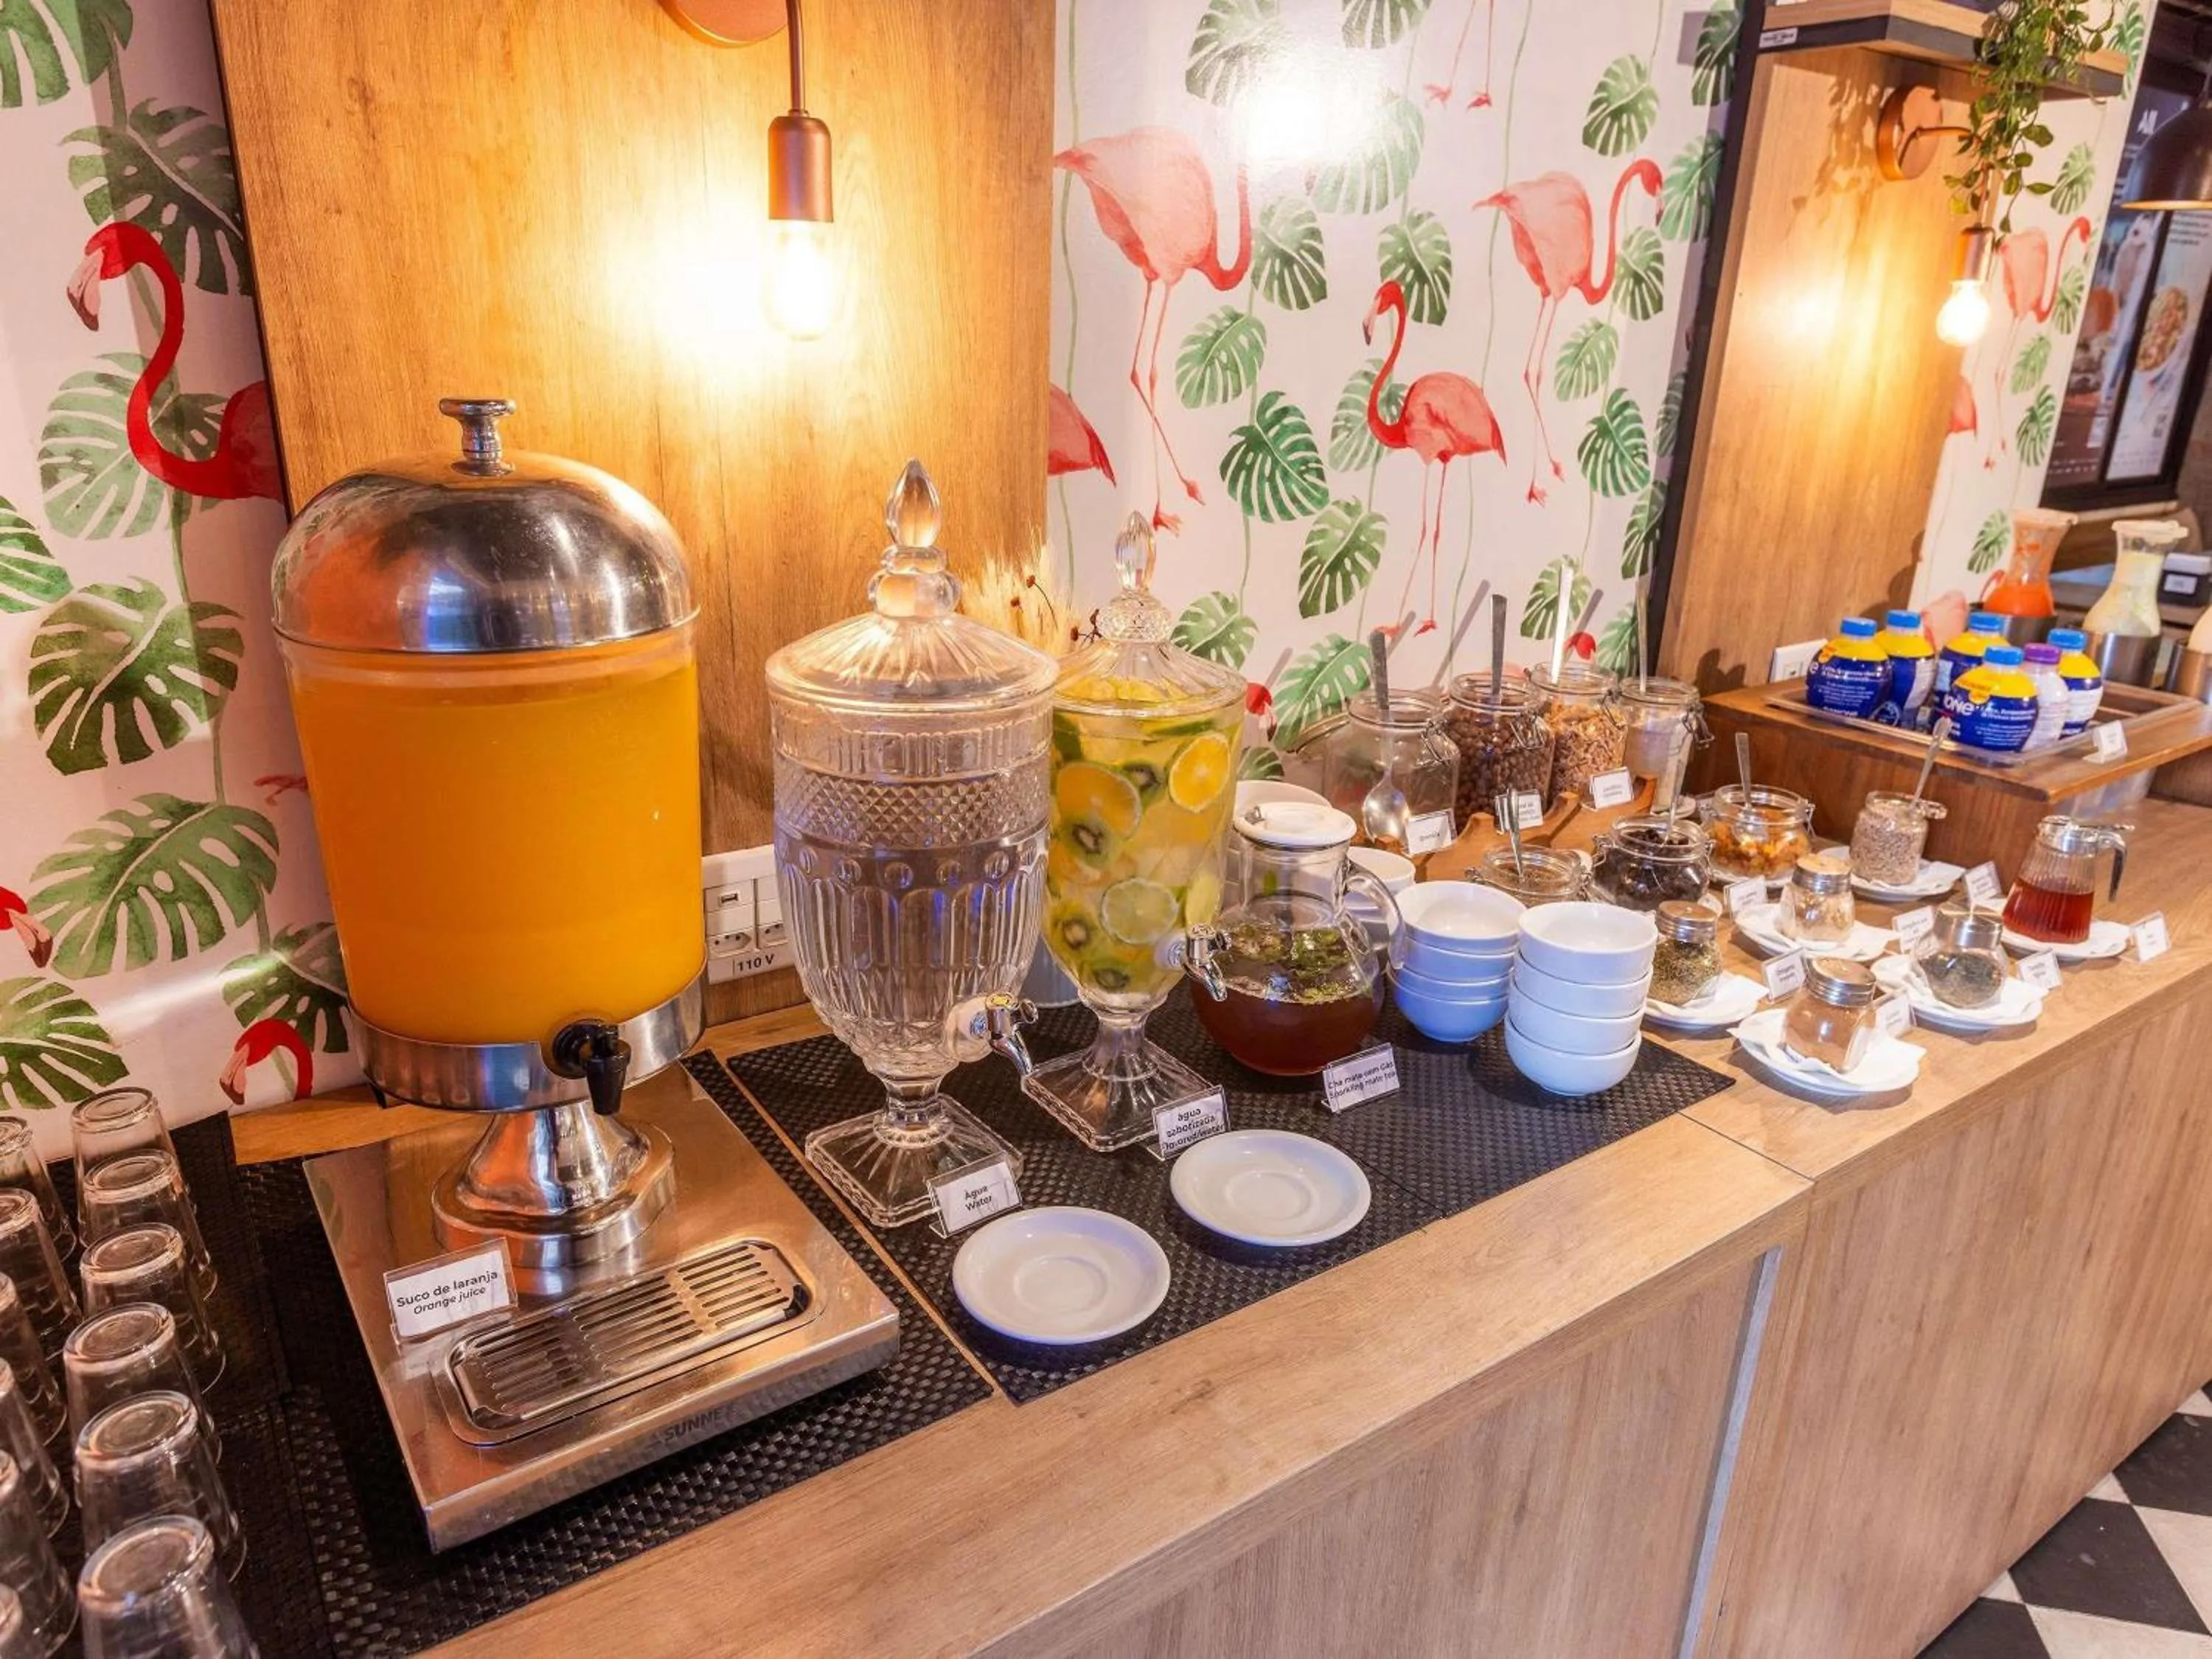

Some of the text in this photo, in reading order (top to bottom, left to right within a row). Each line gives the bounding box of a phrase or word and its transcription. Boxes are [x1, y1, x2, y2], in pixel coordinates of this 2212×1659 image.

[737, 953, 775, 972] 110 V
[964, 1195, 992, 1211] Water
[396, 1270, 498, 1307] Suco de laranja
[413, 1286, 487, 1315] Orange juice
